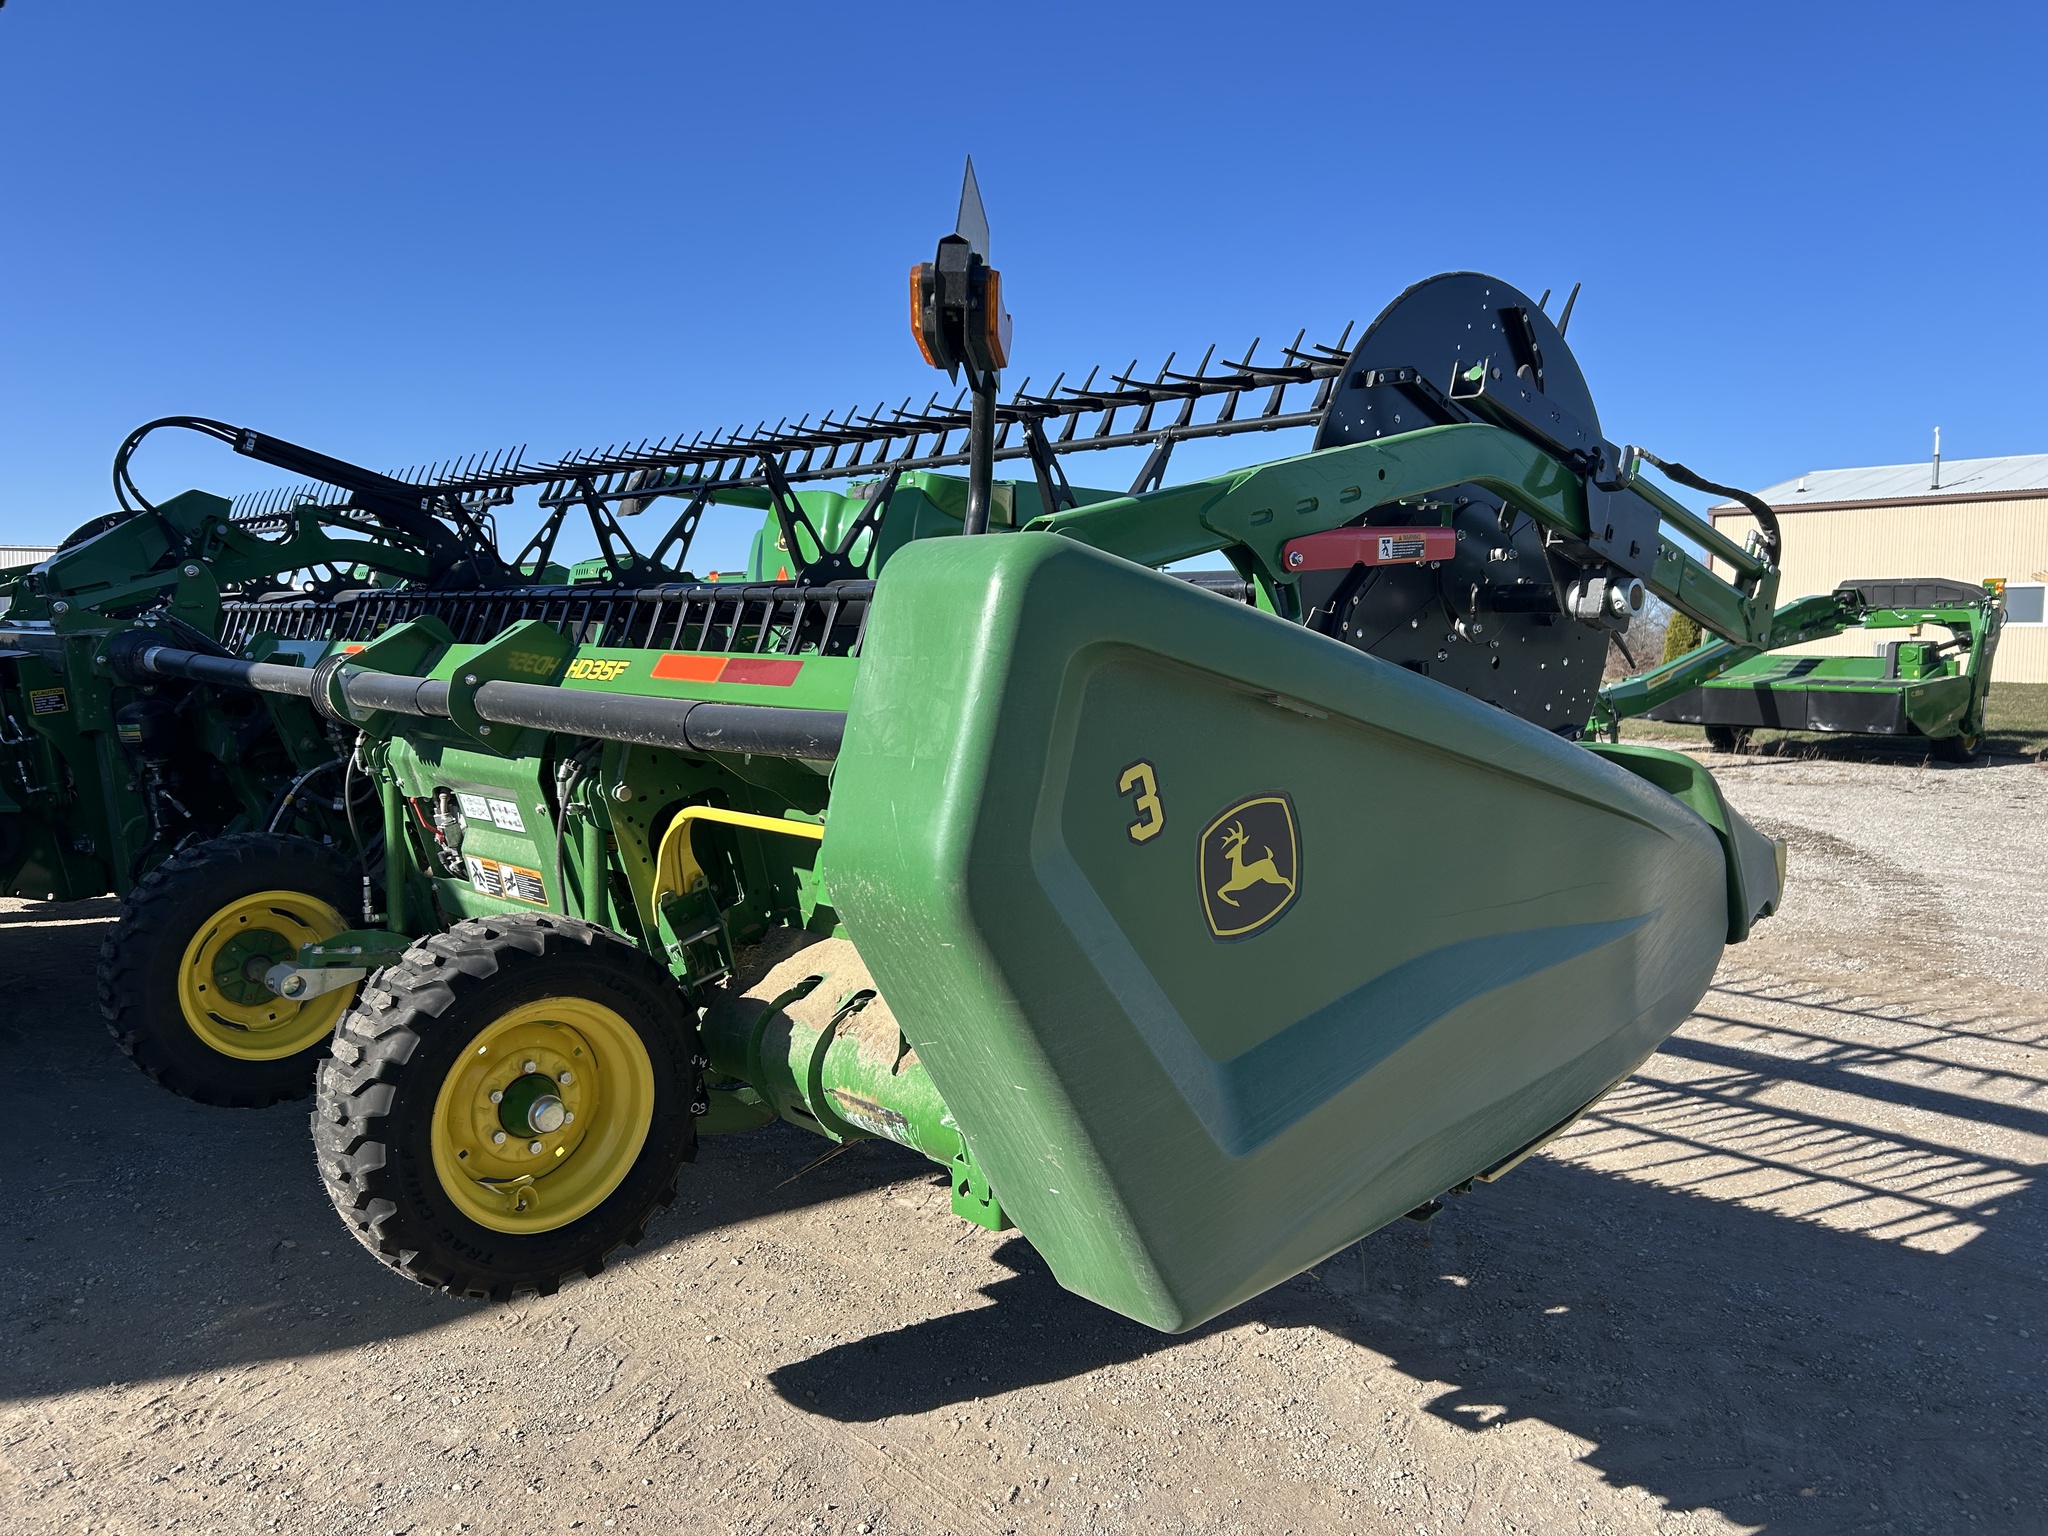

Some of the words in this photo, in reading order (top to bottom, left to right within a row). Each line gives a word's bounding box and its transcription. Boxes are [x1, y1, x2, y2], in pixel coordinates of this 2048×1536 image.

[1526, 393, 1532, 403] 3
[1555, 413, 1561, 424] 2
[564, 658, 631, 681] HD35F
[37, 688, 64, 696] CAUTION
[1118, 760, 1165, 843] 3
[607, 974, 690, 1094] CARLISLE
[436, 1226, 495, 1266] TRAC
